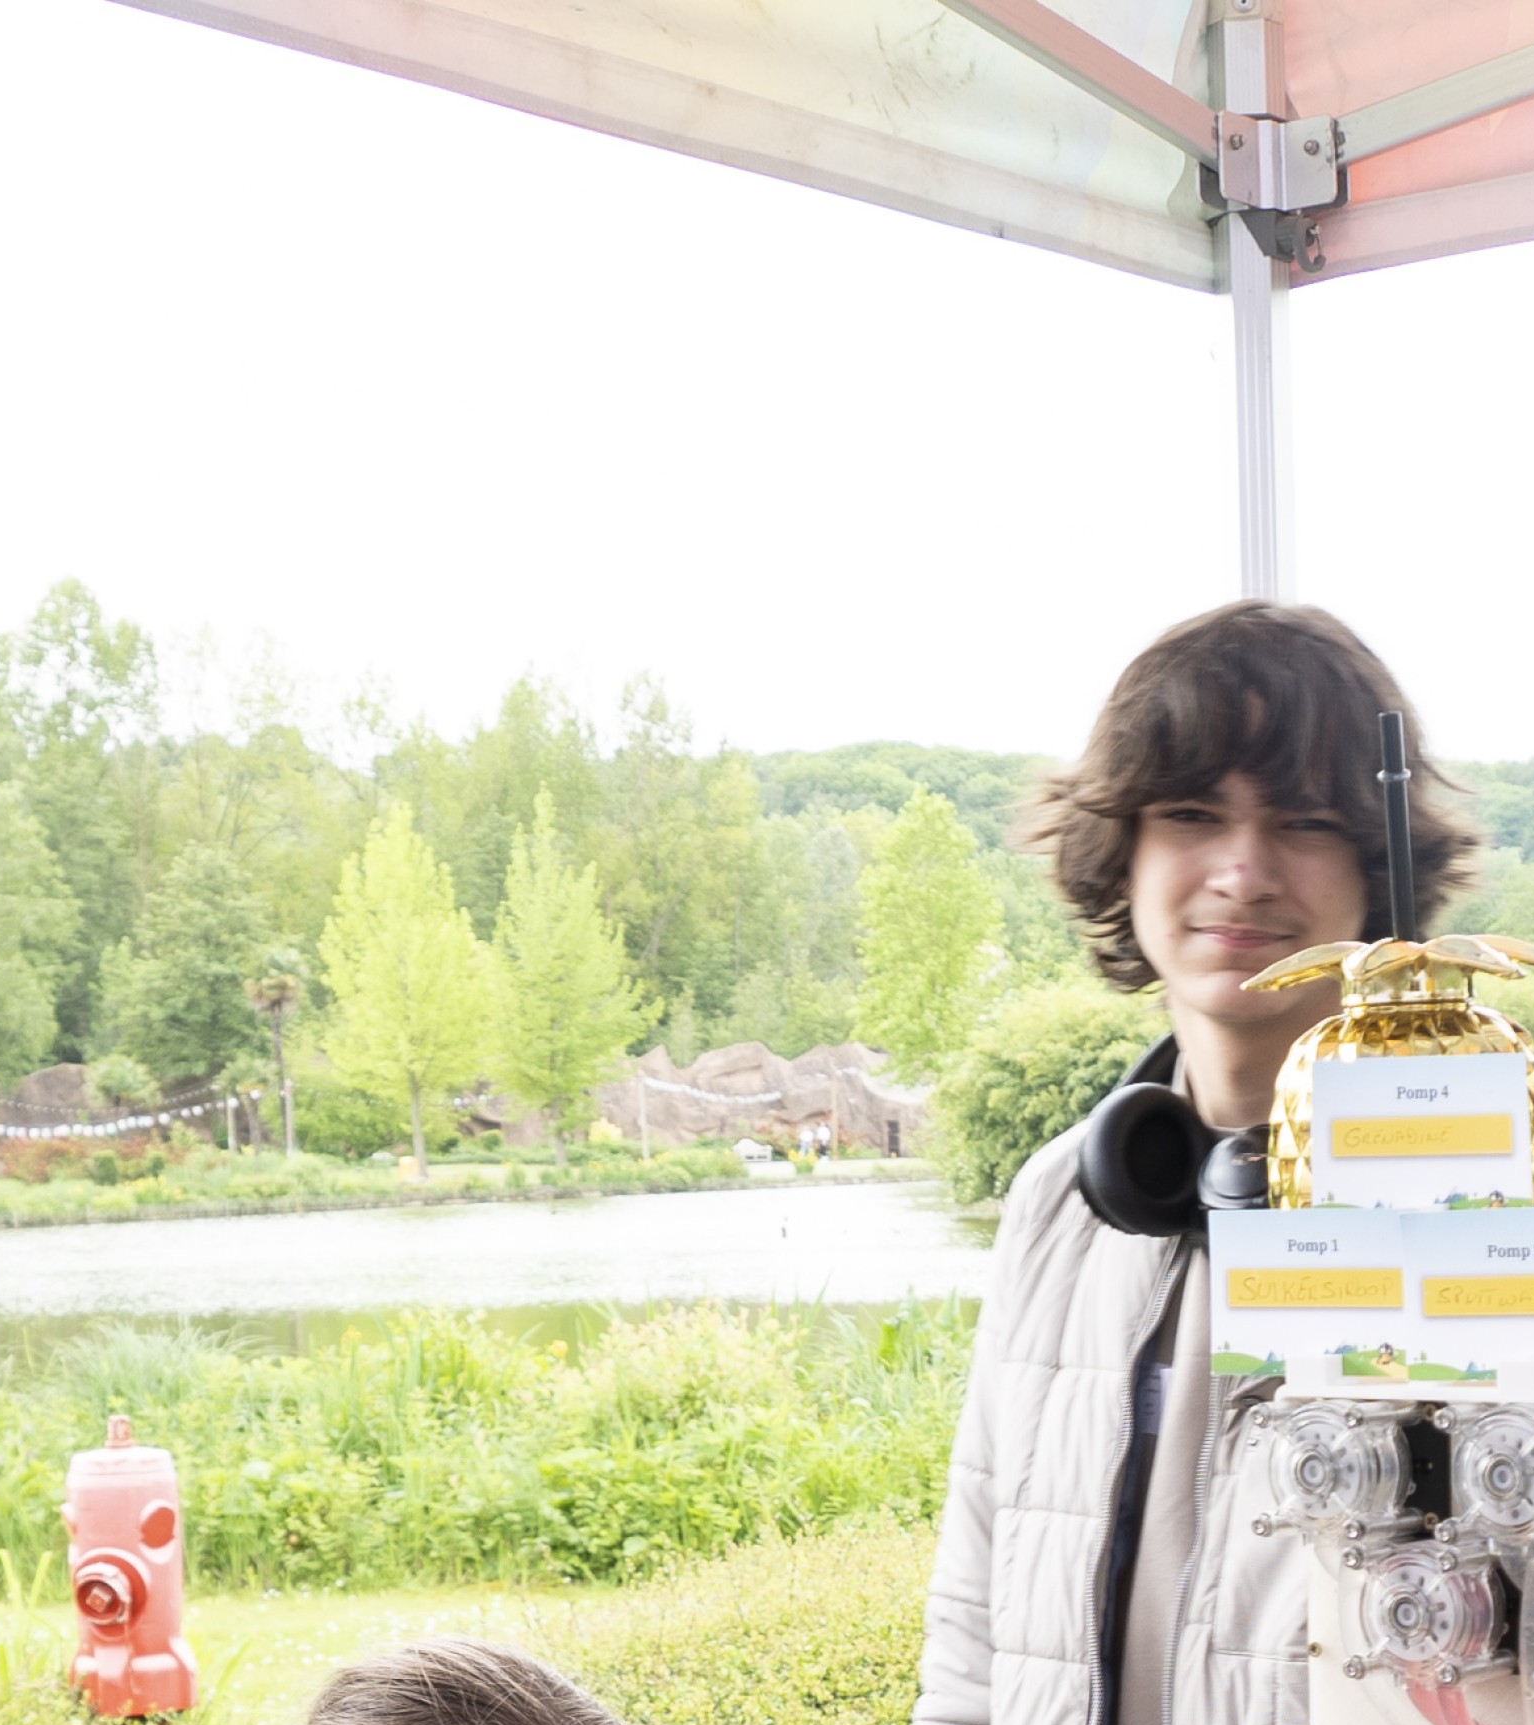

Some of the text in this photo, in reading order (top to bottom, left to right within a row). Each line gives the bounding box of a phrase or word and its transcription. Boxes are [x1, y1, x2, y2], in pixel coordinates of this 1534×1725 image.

[1396, 1085, 1450, 1102] Pomp 4
[1287, 1238, 1340, 1256] Pomp 1
[1487, 1244, 1531, 1261] Pomp
